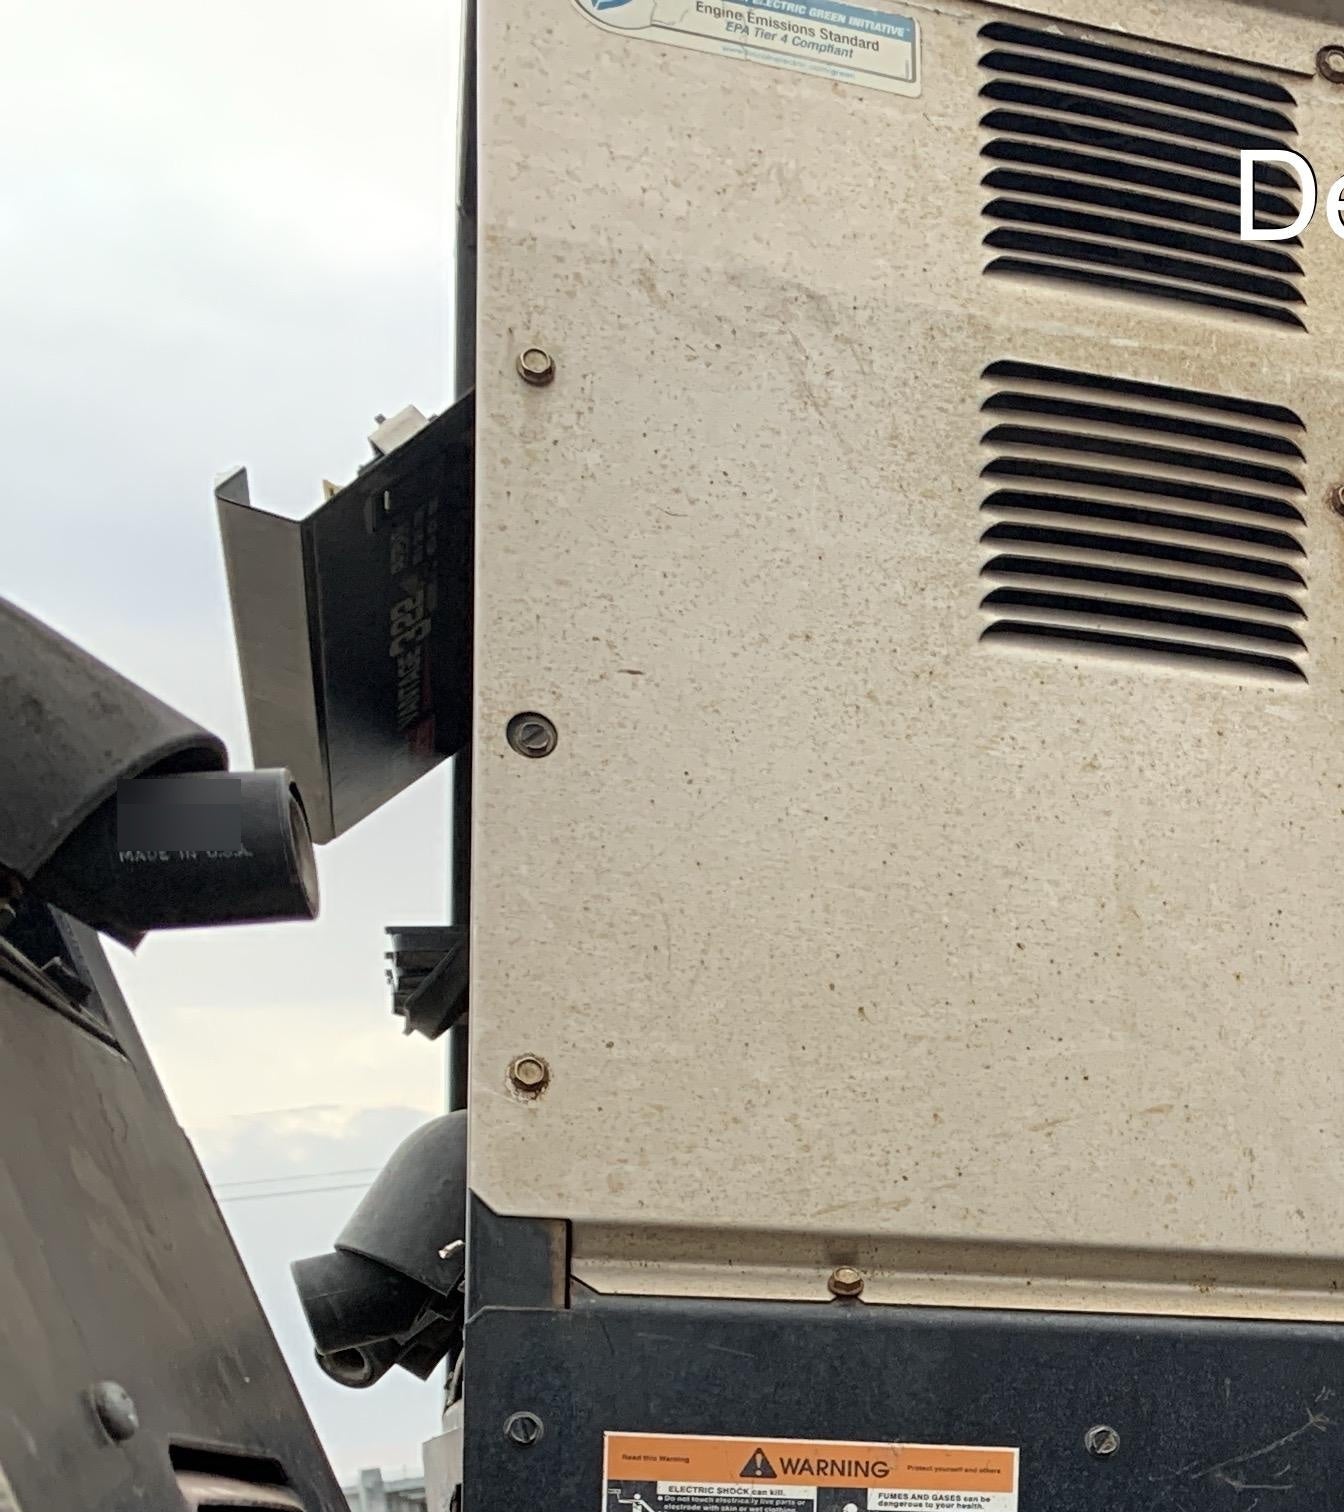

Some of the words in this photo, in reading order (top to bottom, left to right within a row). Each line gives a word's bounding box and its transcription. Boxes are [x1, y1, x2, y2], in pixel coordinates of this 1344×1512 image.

[695, 0, 743, 21] Engine
[747, 9, 816, 38] Emissions
[820, 27, 880, 52] Standard
[809, 7, 846, 24] GREEN
[849, 15, 905, 37] INITIATIVE
[725, 21, 750, 36] EPA
[755, 27, 778, 42] Tier
[780, 34, 788, 44] 4
[791, 36, 854, 59] Compliant
[780, 1457, 890, 1478] WARNING
[668, 1485, 715, 1494] ELECTRIC
[878, 1492, 909, 1500] FUMES
[909, 1493, 930, 1501] AND
[930, 1494, 962, 1502] GASES
[979, 1495, 991, 1503] be
[878, 1500, 923, 1510] dangerous
[934, 1502, 954, 1510] your
